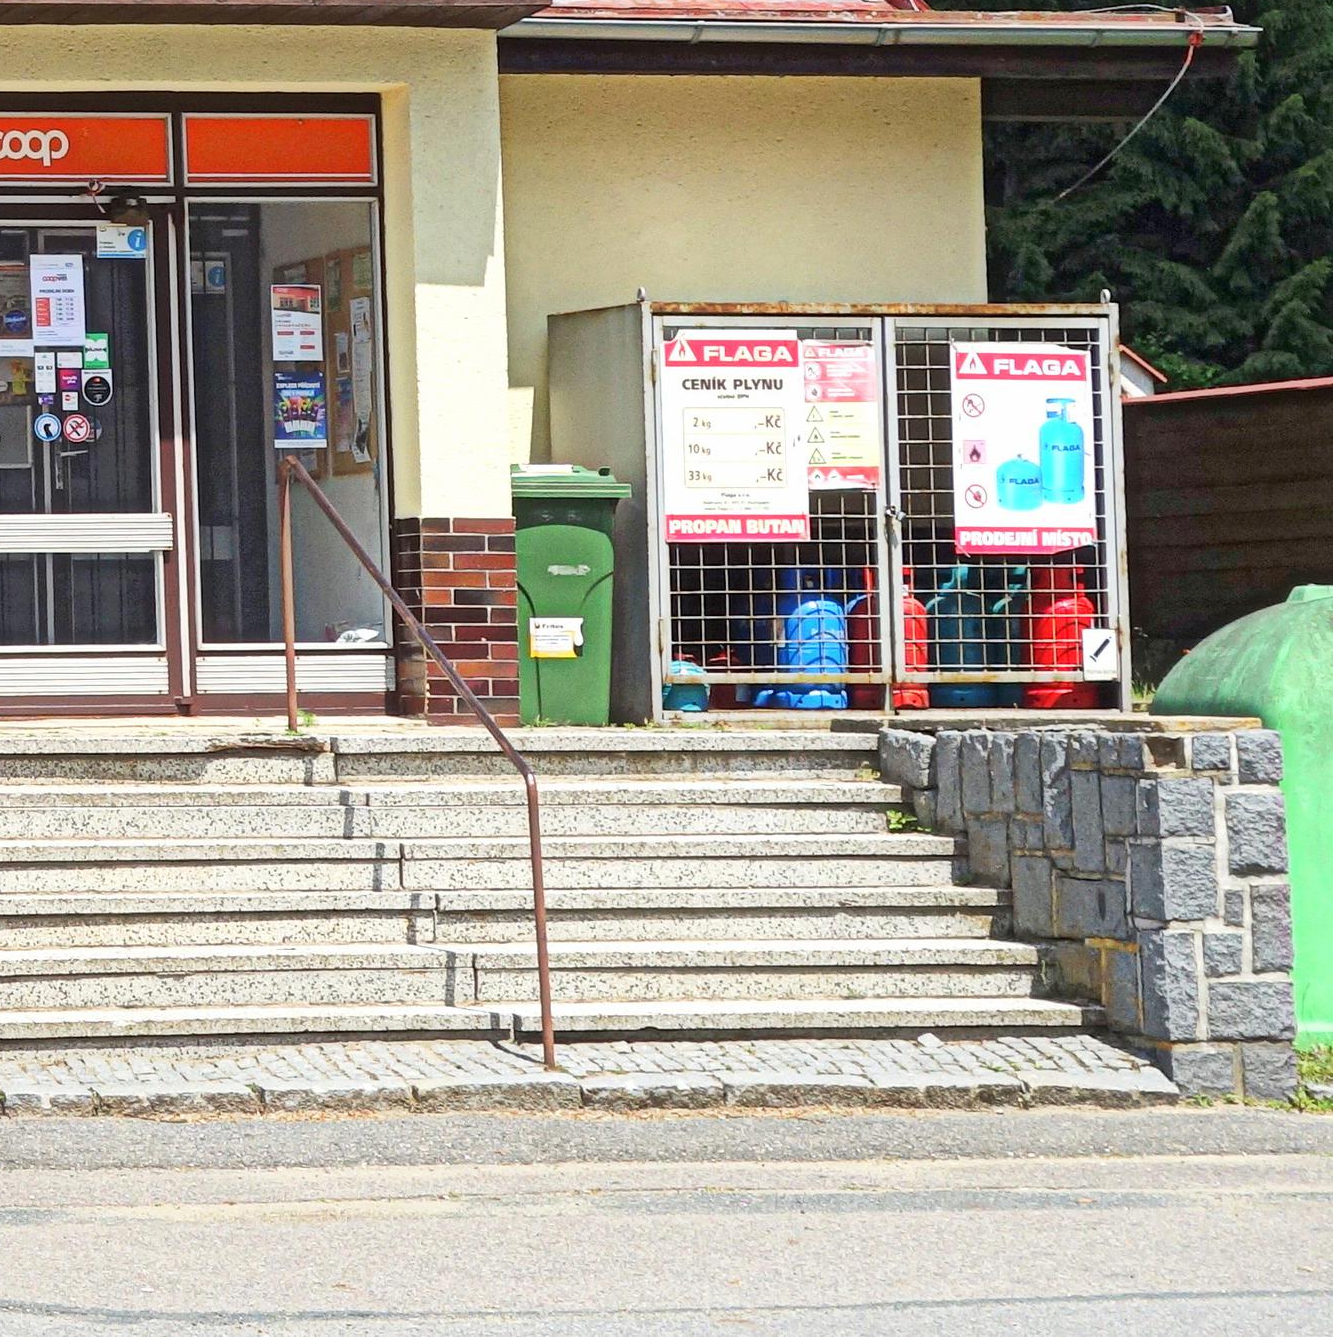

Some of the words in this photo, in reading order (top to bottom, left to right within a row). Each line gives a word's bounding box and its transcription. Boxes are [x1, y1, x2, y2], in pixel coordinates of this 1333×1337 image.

[703, 345, 793, 362] FLAGA
[993, 358, 1082, 376] FLAGA
[682, 376, 727, 390] CENÍK
[733, 378, 784, 391] PLYNU
[693, 417, 699, 428] 2
[701, 420, 712, 429] kg
[688, 443, 700, 454] 10
[701, 447, 712, 455] kg
[1051, 444, 1082, 452] FLAGA
[688, 470, 701, 481] 33
[702, 473, 713, 482] kg
[1009, 477, 1040, 485] FLAGA
[669, 519, 742, 535] PROPAN
[746, 519, 806, 534] BUTAN
[960, 528, 1038, 547] PRODEJNÍ
[1042, 527, 1092, 546] MÍSTO
